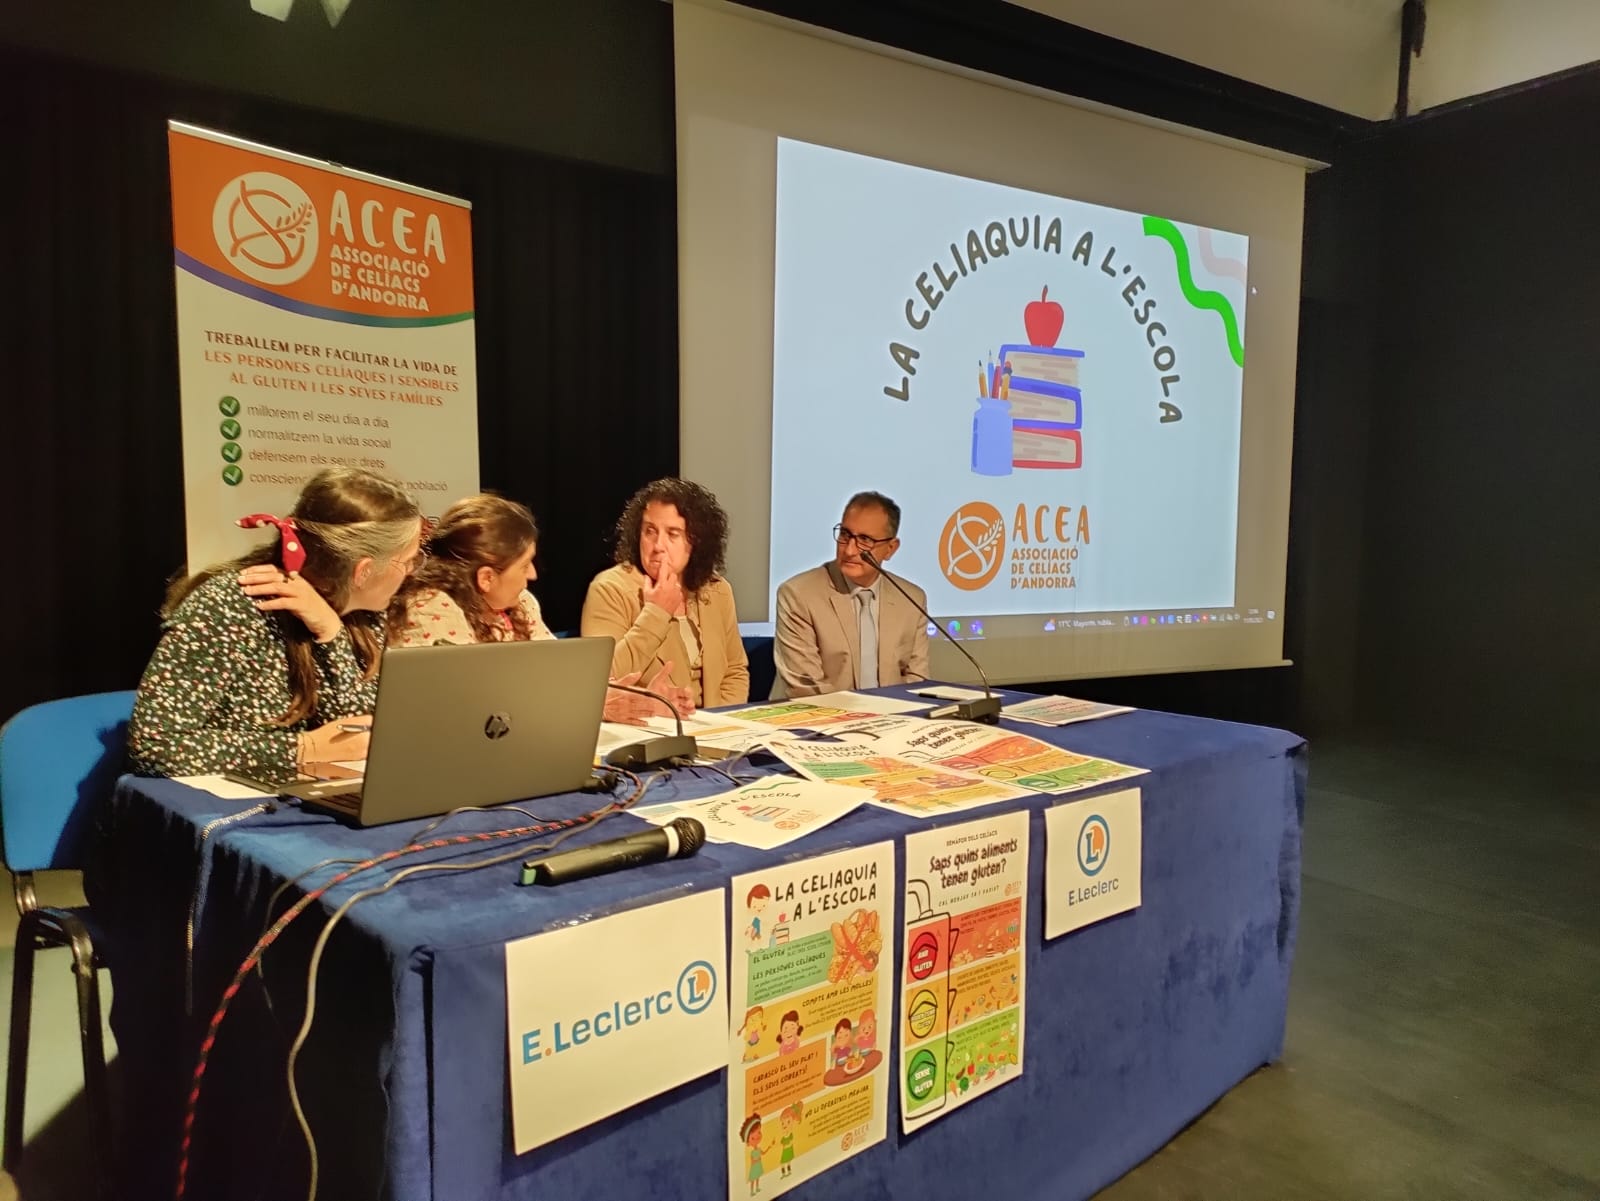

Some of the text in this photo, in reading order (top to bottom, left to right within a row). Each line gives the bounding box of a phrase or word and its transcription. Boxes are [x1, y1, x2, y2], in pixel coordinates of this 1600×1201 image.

[329, 189, 446, 264] ACEA
[330, 243, 430, 279] ASSOCIACIÓ
[331, 261, 352, 279] DE
[331, 281, 430, 312] D'ANDORRA
[883, 215, 1183, 424] LA CELIAQUIA A L'ESCOLA
[205, 330, 457, 376] TREBALLEM PER FACILITAR LA VIDA DE
[204, 350, 232, 364] LES
[238, 354, 311, 374] PERSONES
[398, 376, 459, 393] SENSIBLES
[230, 372, 247, 385] AL
[253, 375, 307, 392] GLUTEN
[320, 383, 345, 396] LES
[349, 387, 386, 401] SEVES
[248, 405, 390, 428] millorem el seu dia a dia
[248, 427, 391, 449] normalitzem la vida social
[248, 449, 307, 466] defensem
[310, 452, 327, 465] els
[359, 454, 385, 469] drets
[1012, 503, 1090, 544] ACEA
[1011, 546, 1078, 561] ASSOCIACIÓ
[1011, 563, 1024, 575] DE
[1011, 577, 1076, 590] D'ANDORRA
[930, 838, 1018, 875] Saps quins aliments
[775, 861, 877, 902] LA CELIAQUIA
[940, 858, 1007, 889] tenen gluten?
[793, 883, 876, 921] A L'ESCOLA
[1068, 878, 1119, 906] E.Leclerc
[752, 972, 764, 981] LES
[765, 962, 795, 978] PERSONES
[802, 994, 825, 1008] COMPTE
[840, 986, 850, 995] LES
[522, 990, 673, 1065] E.Leclerc
